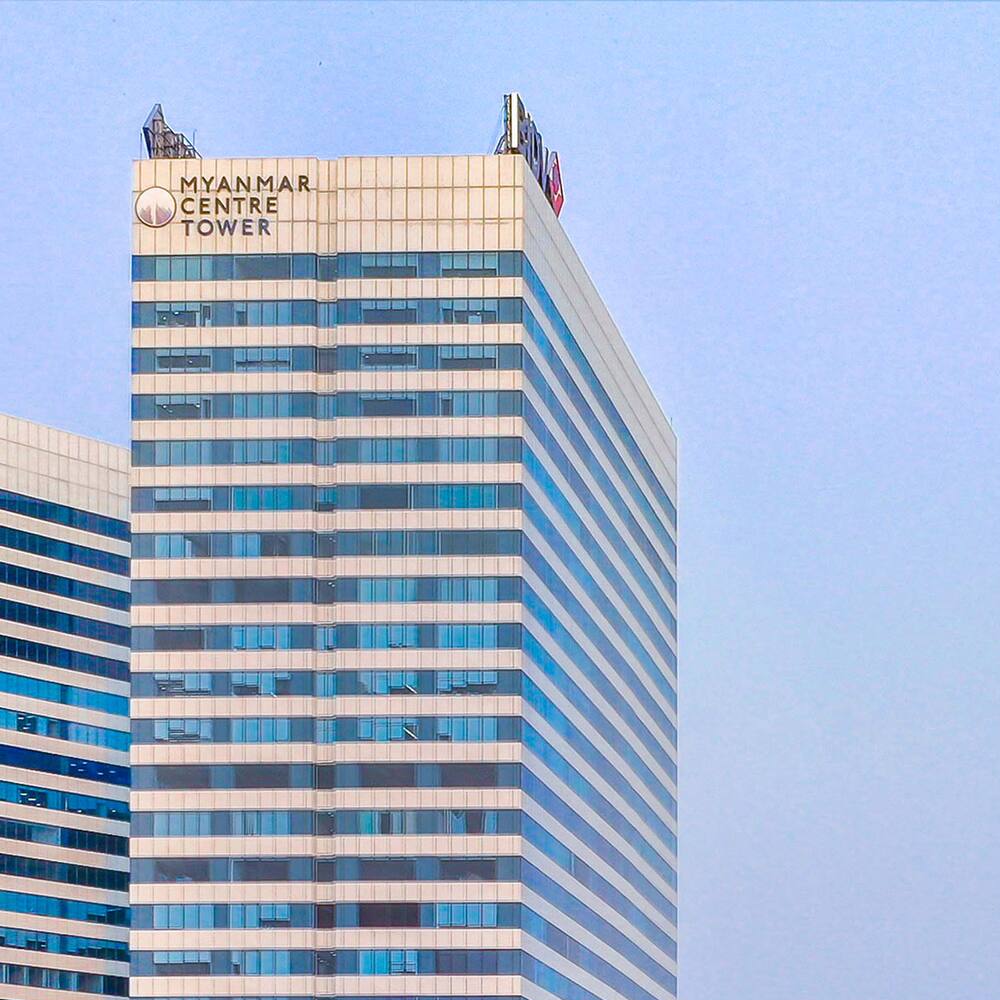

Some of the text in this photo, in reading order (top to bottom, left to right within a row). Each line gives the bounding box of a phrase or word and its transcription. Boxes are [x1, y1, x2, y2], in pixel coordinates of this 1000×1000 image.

[180, 175, 311, 194] MYANMAR
[180, 197, 278, 215] CENTRE
[180, 219, 271, 237] TOWER
